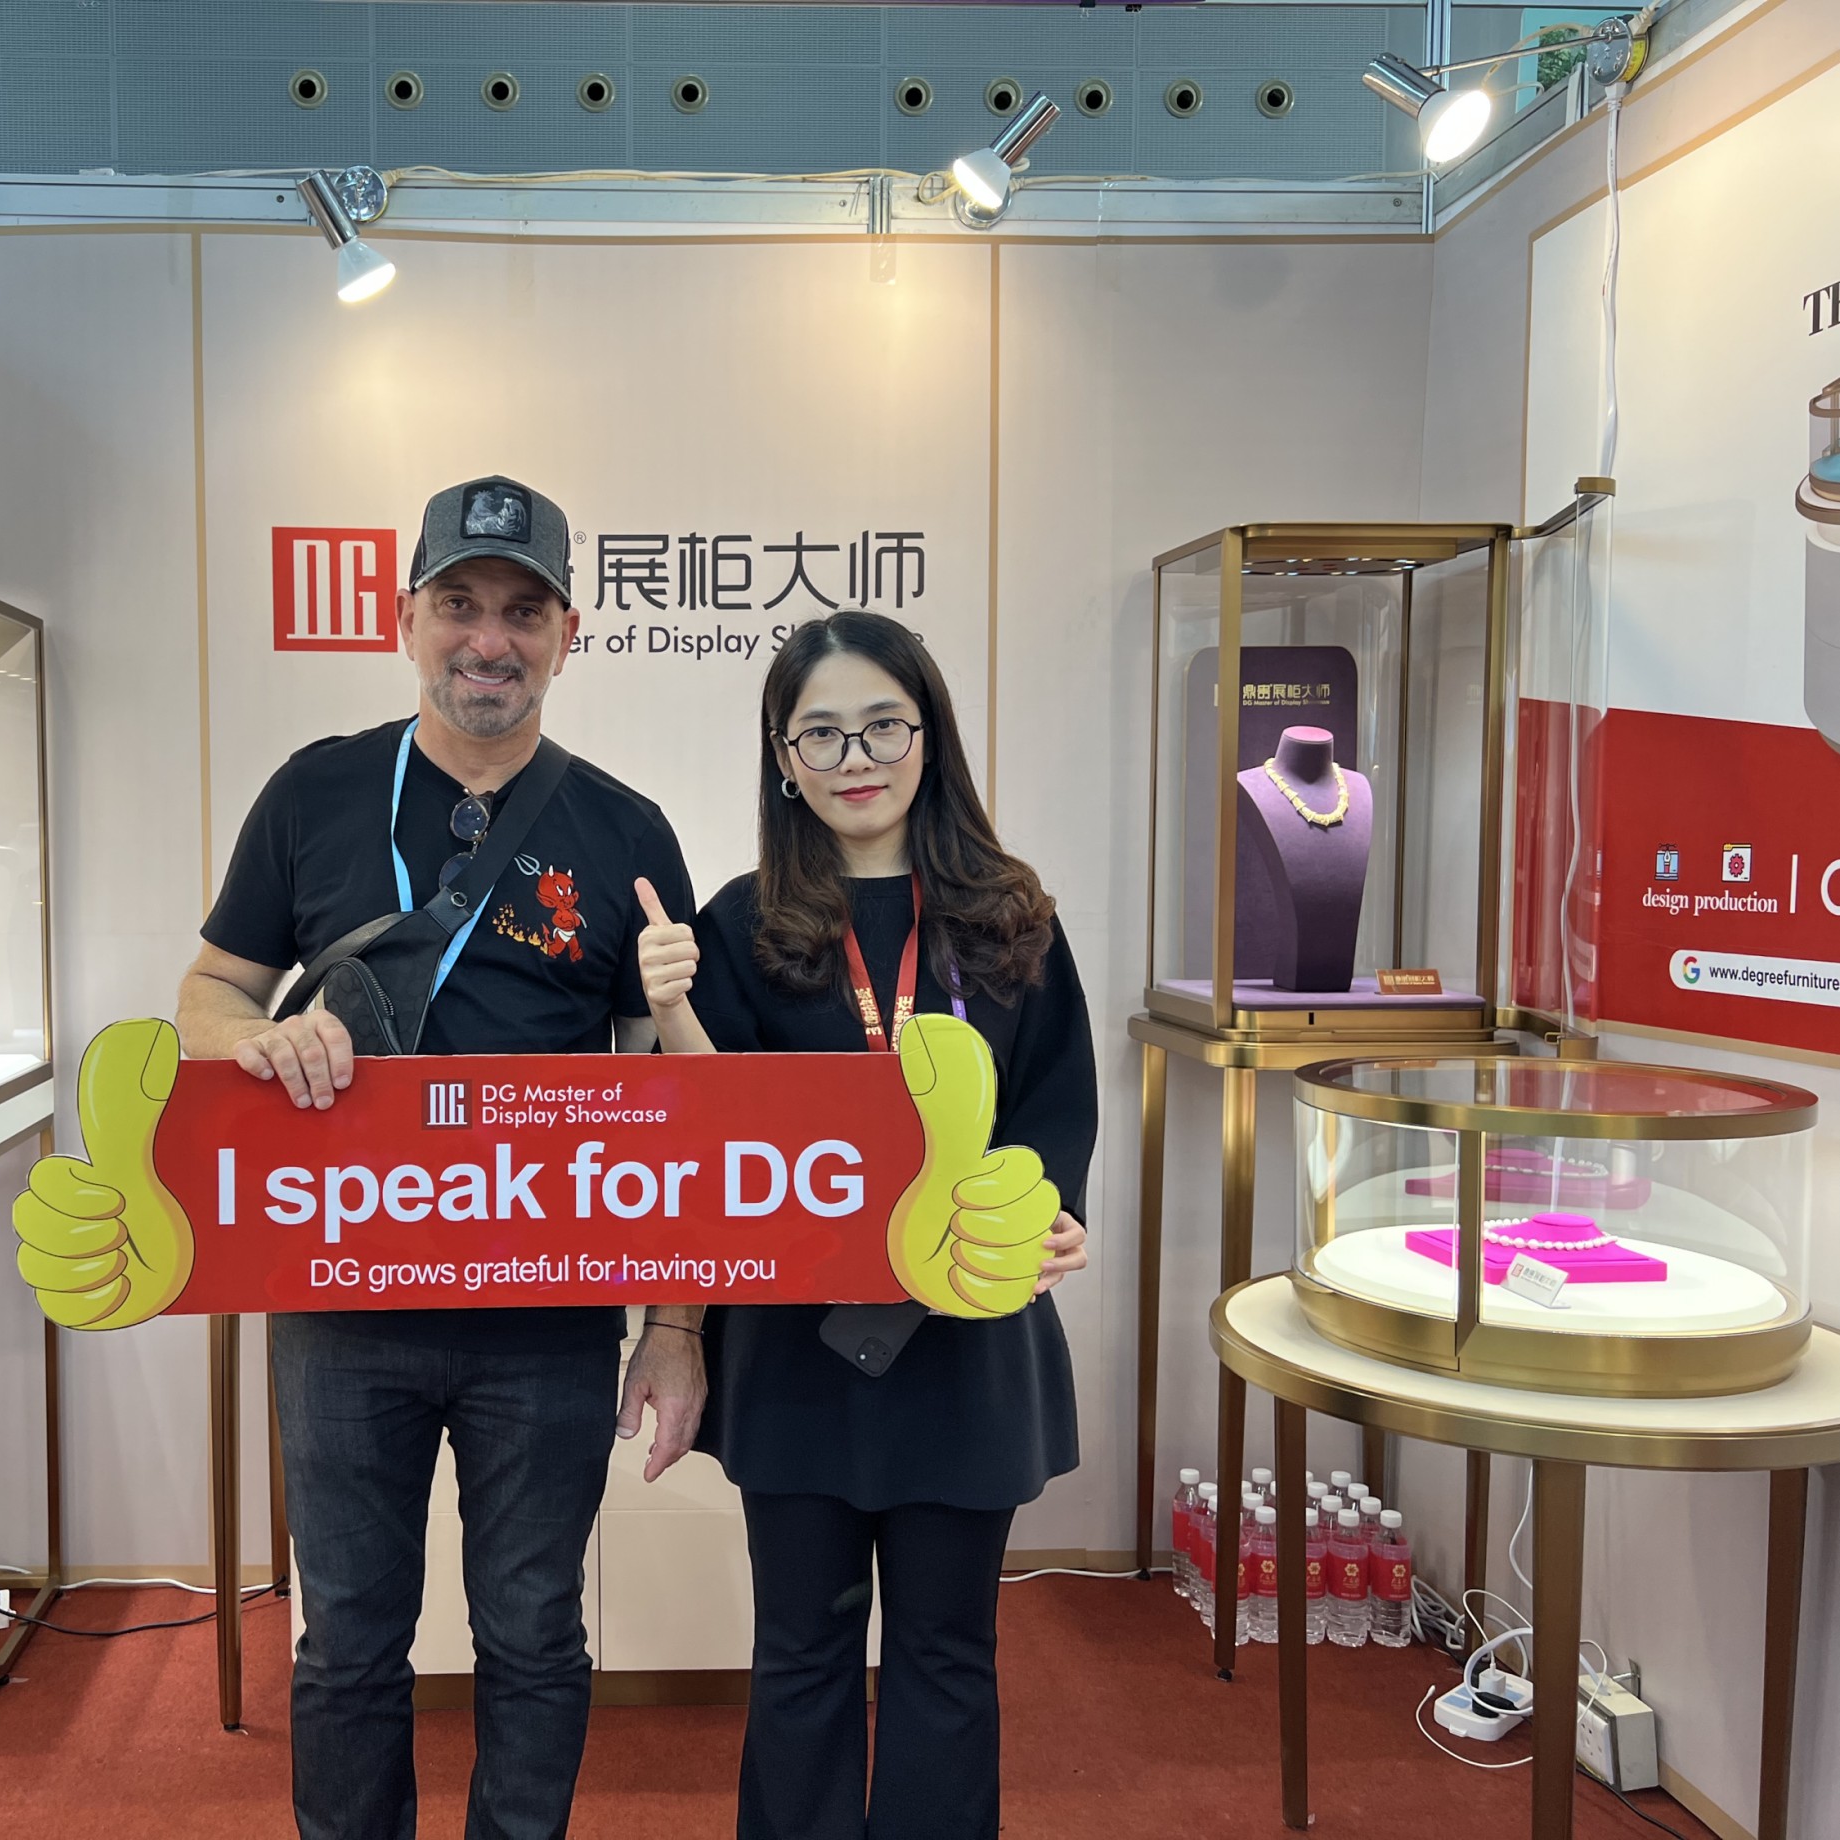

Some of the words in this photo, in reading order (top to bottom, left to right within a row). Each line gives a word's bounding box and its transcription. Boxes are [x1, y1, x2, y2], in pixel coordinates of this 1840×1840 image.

[286, 538, 386, 641] DG
[605, 625, 637, 654] of
[648, 625, 761, 661] Display
[1642, 887, 1689, 915] design
[1693, 890, 1778, 916] production
[426, 1083, 468, 1126] DG
[481, 1084, 517, 1103] DG
[523, 1084, 595, 1103] Master
[601, 1081, 623, 1102] of
[481, 1105, 559, 1129] Display
[564, 1104, 668, 1124] Showcase
[218, 1147, 236, 1225] I
[263, 1143, 547, 1244] speak
[568, 1140, 700, 1219] for
[724, 1139, 865, 1218] DG
[310, 1257, 361, 1287] DG
[368, 1262, 457, 1293] grows
[463, 1253, 569, 1291] grateful
[576, 1252, 616, 1281] for
[622, 1252, 716, 1287] having
[723, 1258, 776, 1287] you
